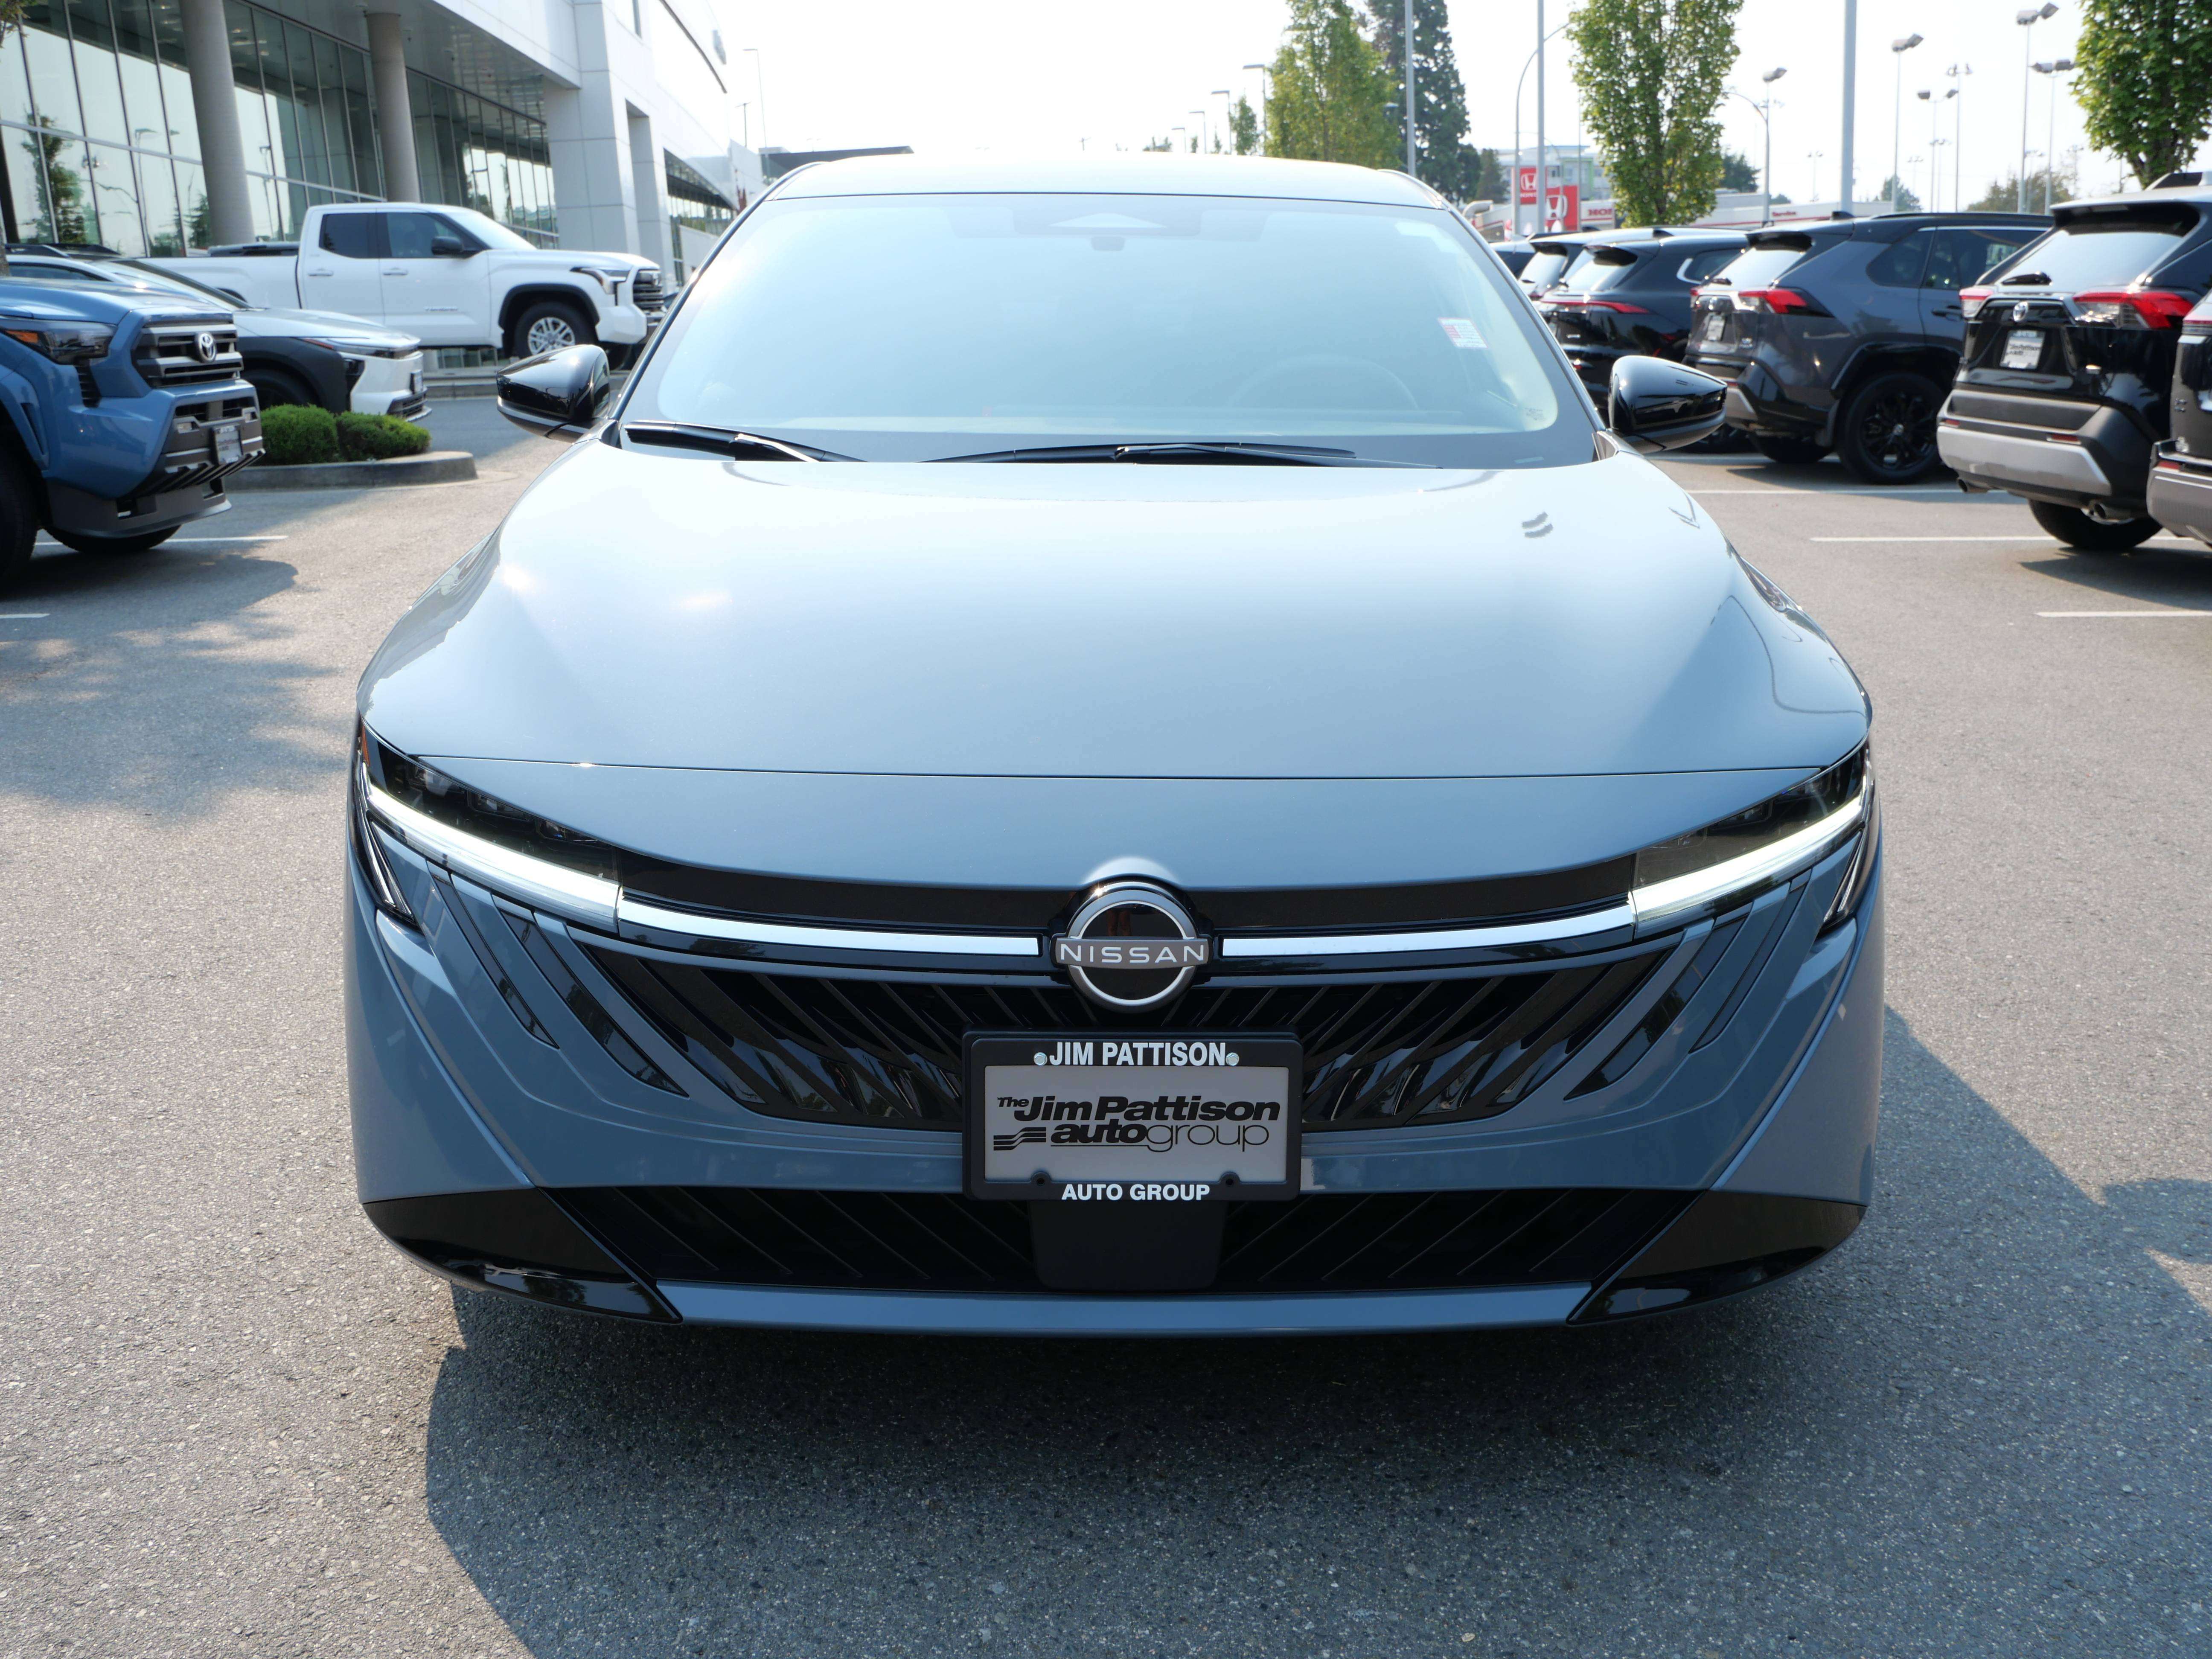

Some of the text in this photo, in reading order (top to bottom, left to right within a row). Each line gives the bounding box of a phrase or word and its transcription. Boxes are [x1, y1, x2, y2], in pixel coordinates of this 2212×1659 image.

[1060, 943, 1204, 963] NISSAN
[1049, 1042, 1226, 1066] JIM PATTISON
[997, 1095, 1281, 1121] The Jim Pattison
[1062, 1184, 1210, 1201] AUTO GROUP
